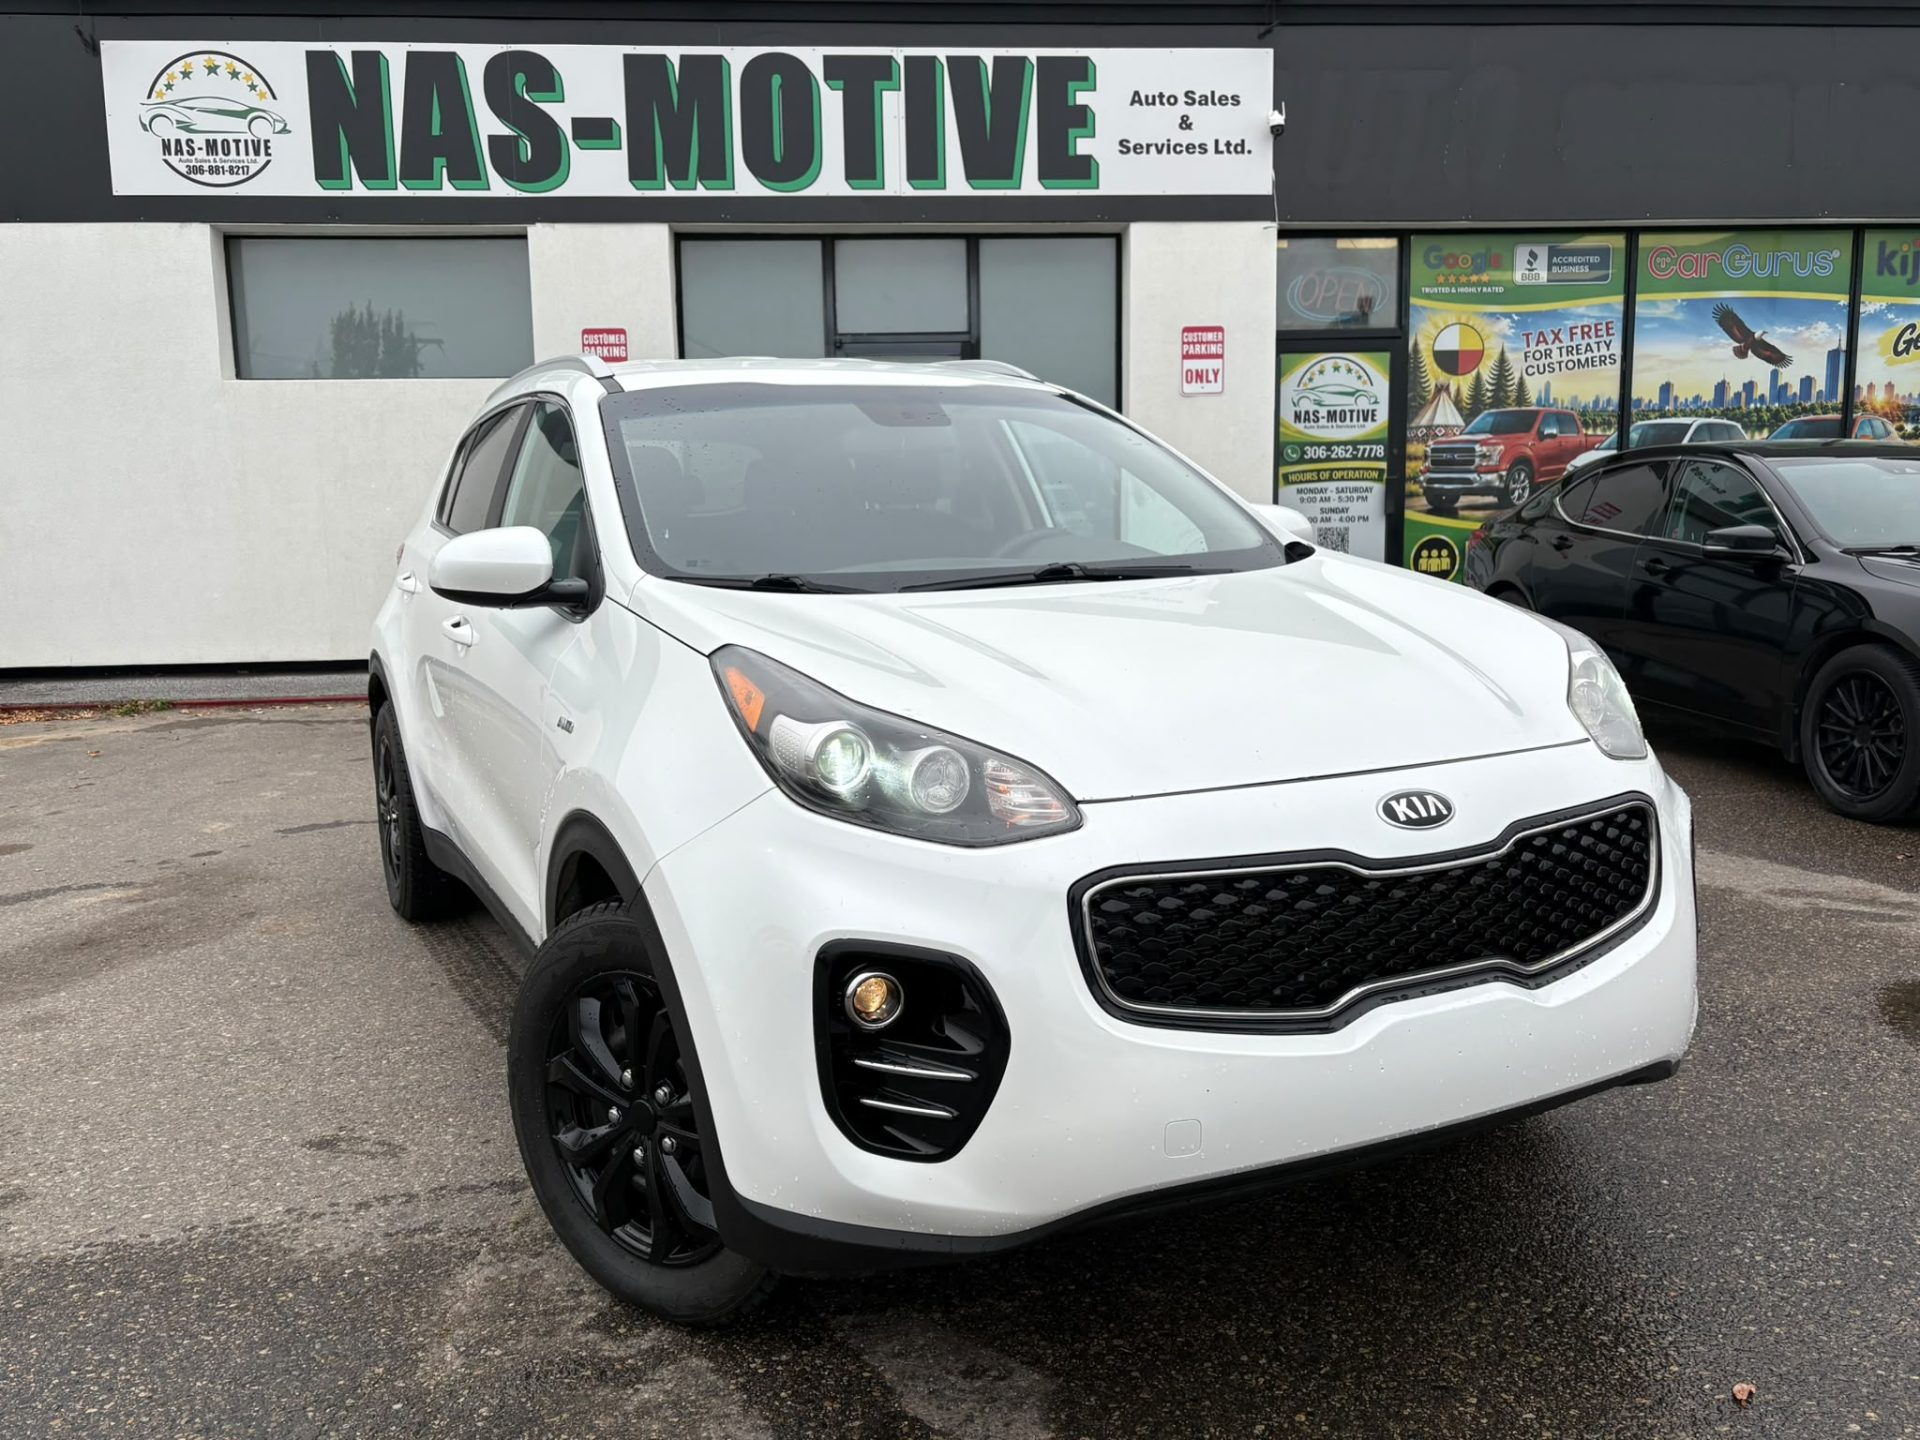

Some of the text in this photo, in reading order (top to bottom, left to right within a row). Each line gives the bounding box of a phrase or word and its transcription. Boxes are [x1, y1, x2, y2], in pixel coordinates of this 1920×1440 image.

[1129, 90, 1241, 107] Auto Sales
[305, 50, 1099, 193] NAS-MOTIVE
[1178, 114, 1193, 131] &
[161, 138, 272, 157] NAS-MOTIVE
[1118, 138, 1252, 155] Services Ltd.
[185, 165, 250, 176] 306-881-8217
[1424, 245, 1504, 275] Google
[1552, 255, 1600, 264] ACCREDITED
[1552, 265, 1589, 273] BUSINESS
[1520, 273, 1541, 281] BBB
[1300, 272, 1374, 313] OPEN
[583, 334, 626, 345] CUSTOMER
[1183, 332, 1223, 342] CUSTOMER
[1522, 320, 1616, 348] TAX FREE
[584, 346, 626, 358] PARKING
[1183, 344, 1223, 355] PARKING
[1523, 340, 1613, 363] FOR TREATY
[1525, 353, 1617, 377] CUSTOMERS
[1185, 368, 1220, 384] ONLY
[1293, 408, 1378, 424] NAS-MOTIVE
[1303, 444, 1385, 459] 306-262-7778
[1288, 469, 1379, 482] HOURS OF OPERATION
[1296, 487, 1328, 495] MONDAY
[1335, 486, 1374, 494] SATURDAY
[1299, 496, 1317, 504] 9:00
[1337, 495, 1355, 503] 5:30
[1356, 495, 1368, 503] PM
[1319, 507, 1350, 515] SUNDAY
[1338, 515, 1356, 523] 4:00
[1388, 795, 1449, 822] KIA
